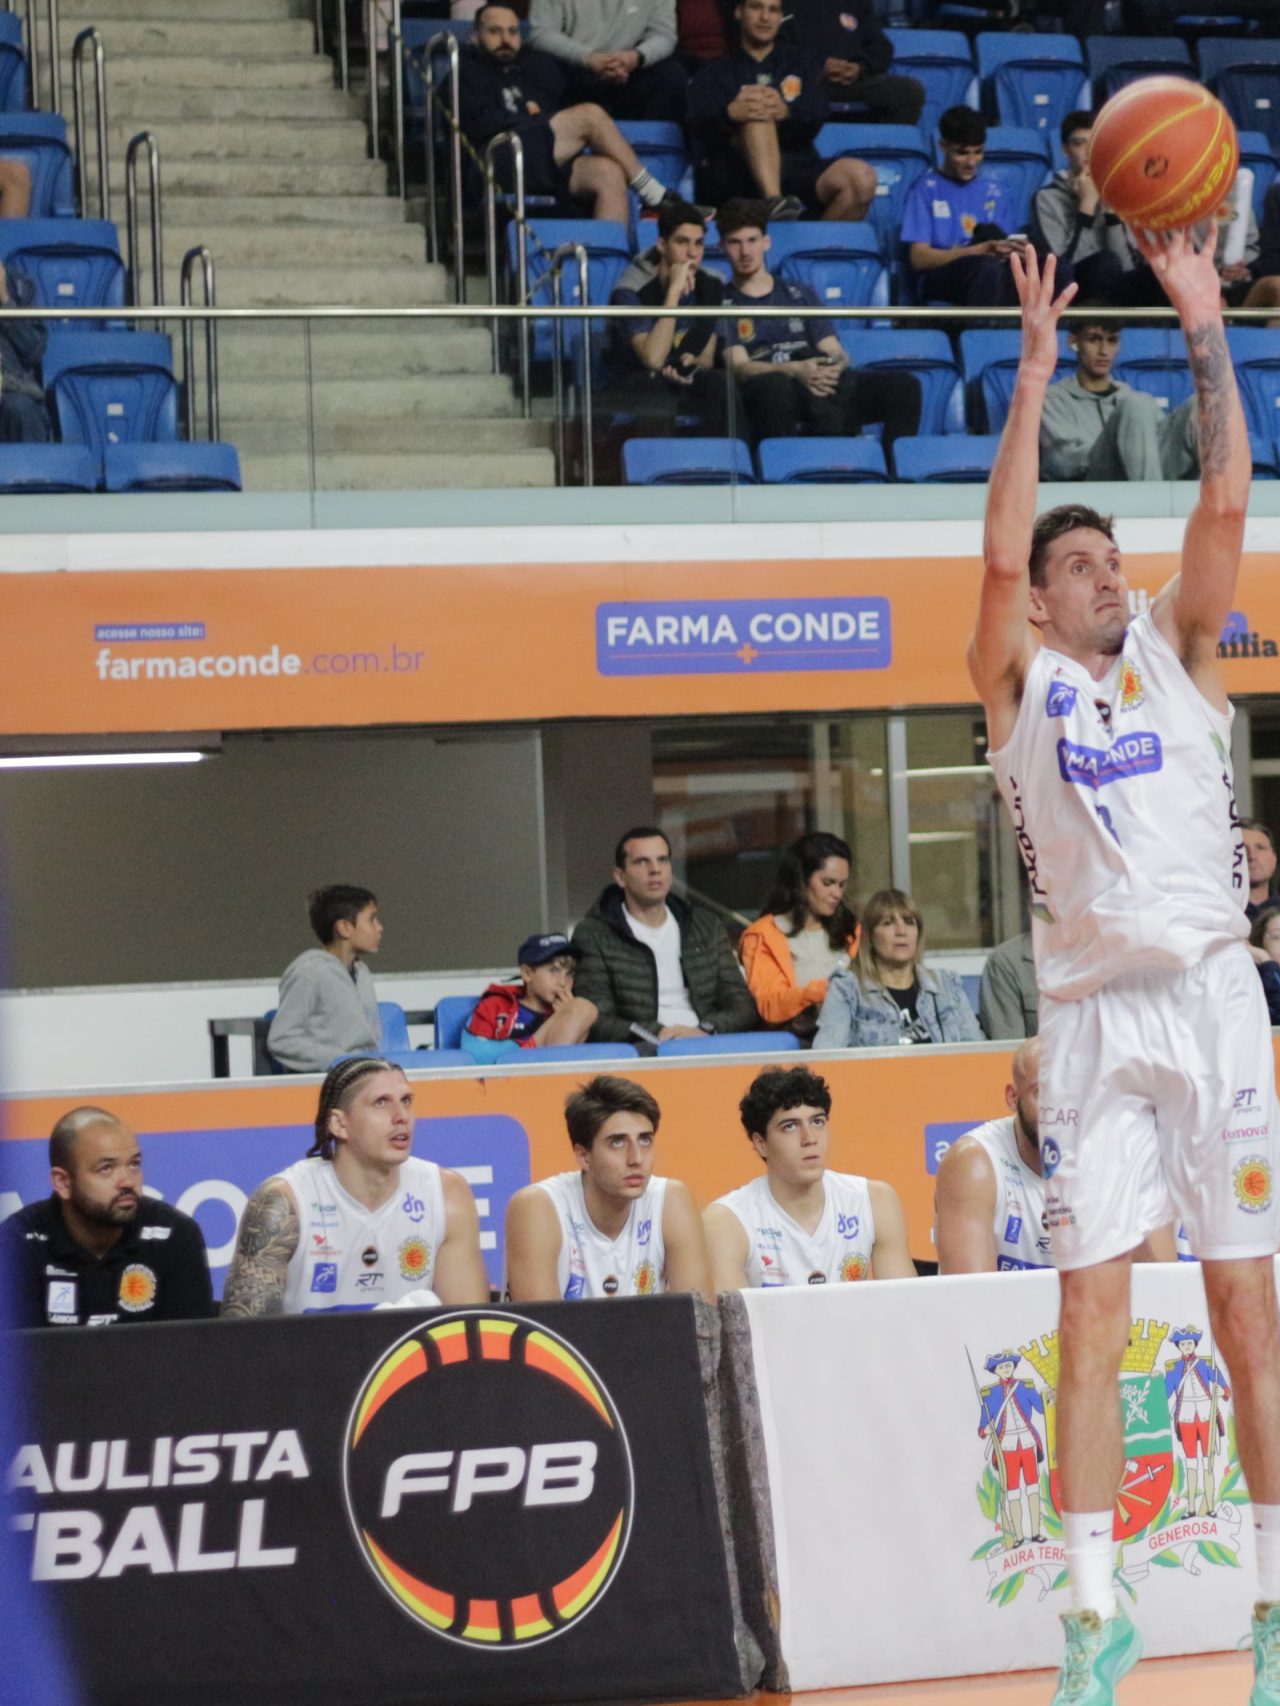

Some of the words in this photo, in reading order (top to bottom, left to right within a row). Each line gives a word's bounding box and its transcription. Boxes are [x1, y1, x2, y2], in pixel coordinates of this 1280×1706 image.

[97, 626, 137, 639] acesse
[140, 626, 175, 638] nosso
[607, 614, 739, 646] FARMA
[750, 611, 880, 643] CONDE
[96, 644, 425, 680] farmaconde.com.br
[380, 1440, 598, 1518] FPB
[1149, 1521, 1218, 1551] GENEROSA
[1002, 1547, 1035, 1572] AURA
